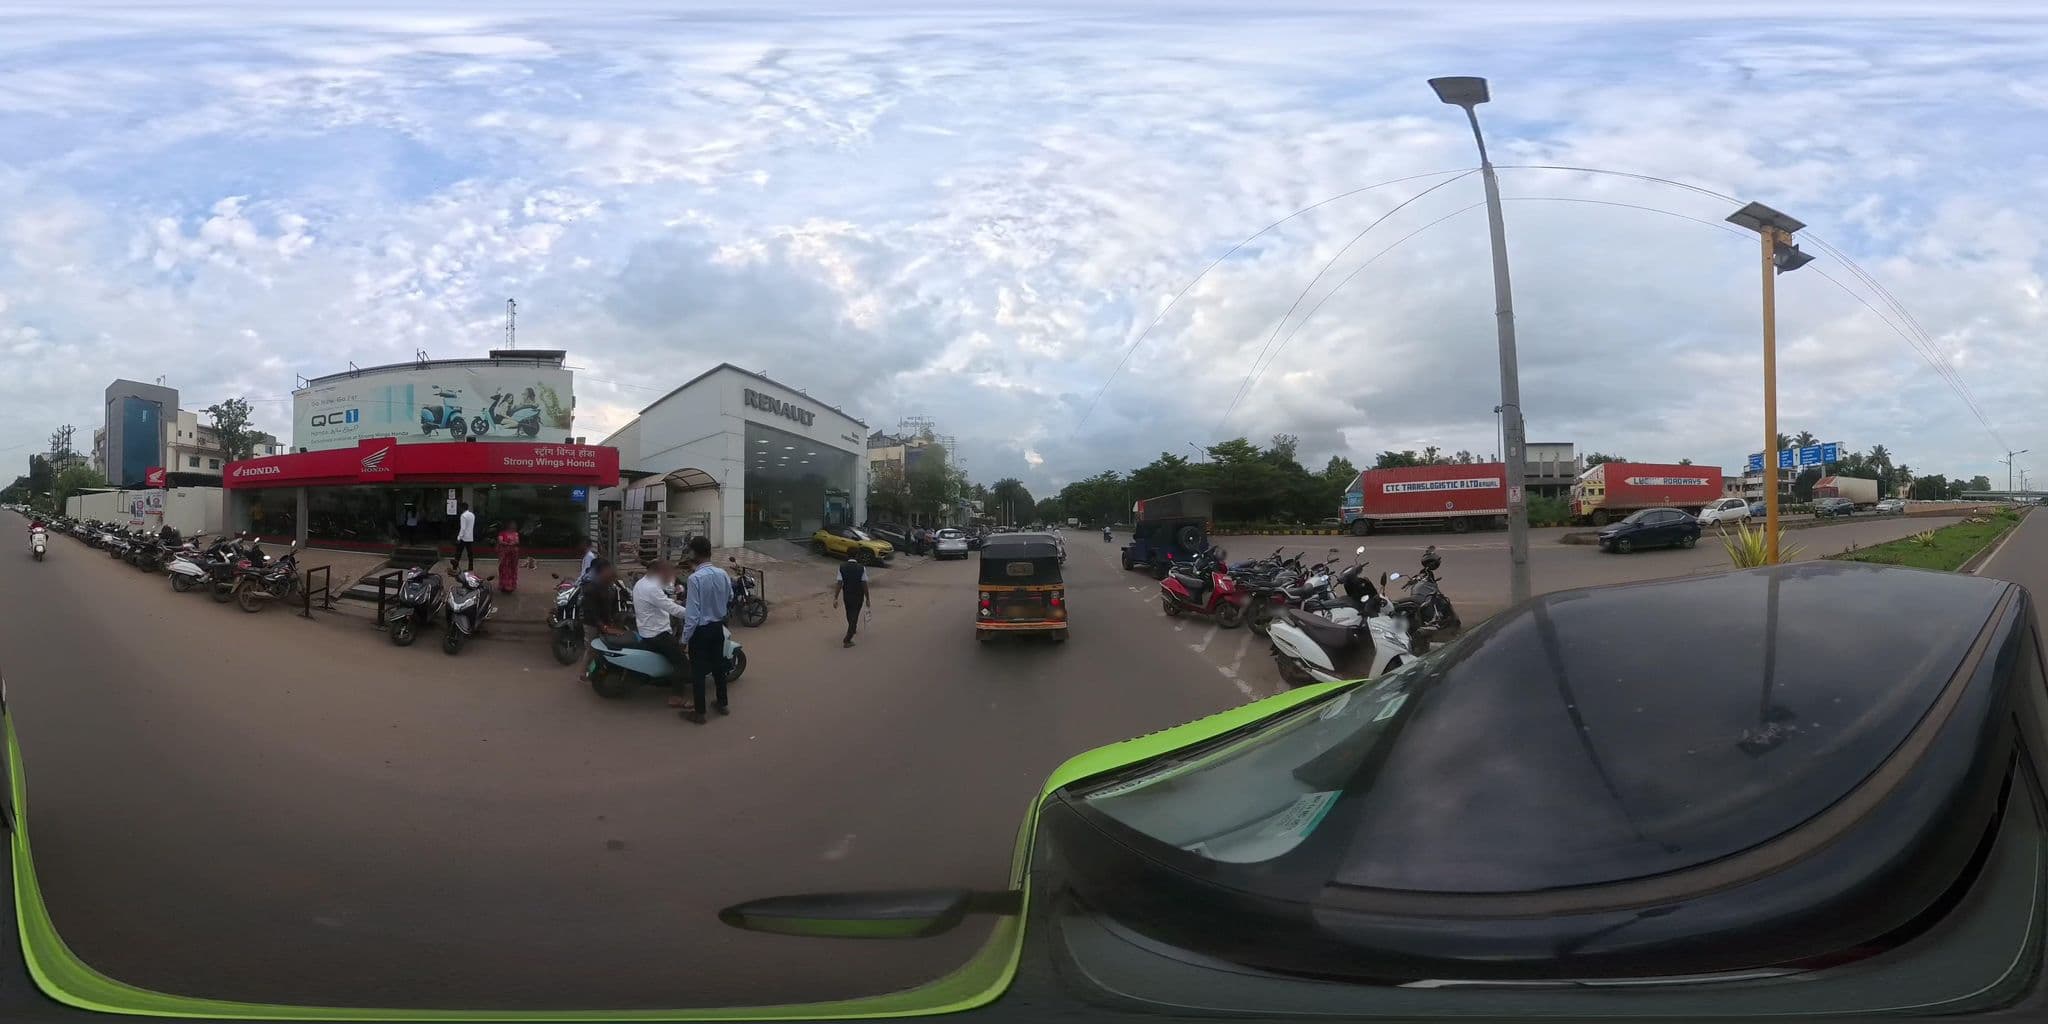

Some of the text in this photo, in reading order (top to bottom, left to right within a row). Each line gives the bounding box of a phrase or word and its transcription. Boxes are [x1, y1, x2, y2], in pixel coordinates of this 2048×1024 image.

[743, 388, 816, 427] RENAULT
[503, 457, 596, 468] Strong Wings Honda
[242, 466, 281, 476] HONDA
[1385, 484, 1400, 492] CTC
[1402, 481, 1458, 491] TRANSLOGISTIC
